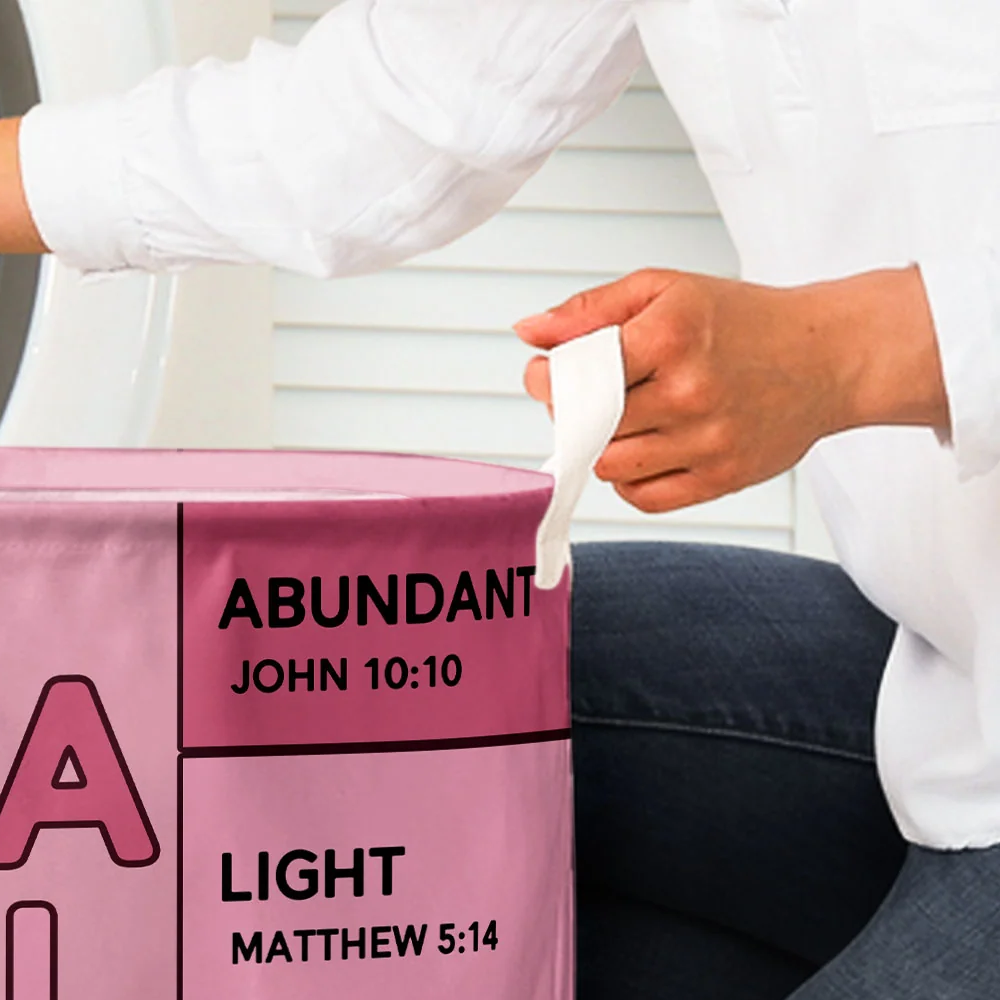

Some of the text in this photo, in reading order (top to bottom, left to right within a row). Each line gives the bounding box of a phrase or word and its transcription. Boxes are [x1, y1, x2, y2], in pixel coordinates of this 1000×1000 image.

[217, 565, 536, 630] ABUNDANT
[230, 653, 463, 695] JOHN 10:10
[221, 846, 406, 903] LIGHT
[232, 919, 499, 965] MATTHEW 5:14
